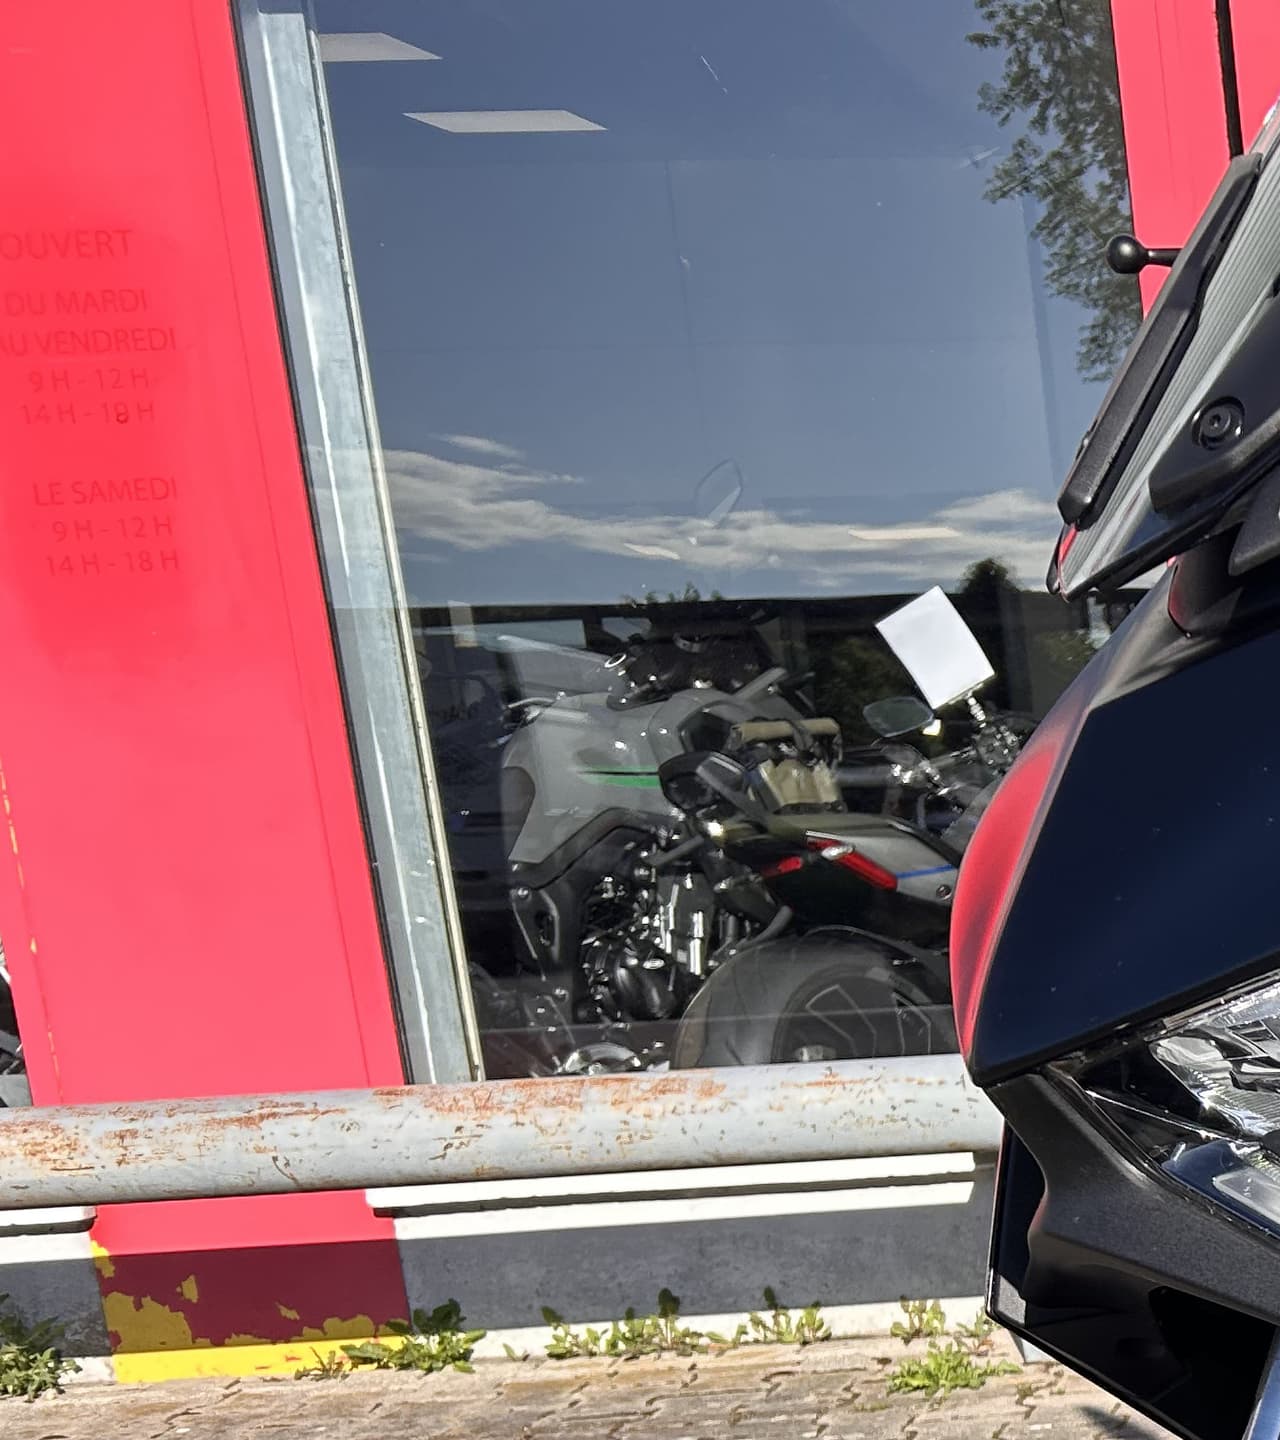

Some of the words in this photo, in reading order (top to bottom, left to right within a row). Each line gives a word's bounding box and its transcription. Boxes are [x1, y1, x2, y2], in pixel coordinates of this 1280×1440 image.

[0, 229, 133, 261] OUVERT
[4, 290, 47, 317] DU
[55, 288, 149, 314] MARDI
[33, 326, 177, 356] VENDREDI
[27, 370, 43, 393] 9
[51, 368, 72, 392] H
[95, 368, 125, 391] 12
[131, 367, 150, 389] H
[20, 403, 52, 425] 14
[57, 401, 77, 424] H
[101, 401, 129, 425] 18
[137, 400, 155, 423] H
[32, 482, 65, 506] LE
[71, 476, 178, 505] SAMEDI
[52, 520, 67, 543] 9
[74, 519, 94, 541] H
[117, 516, 147, 539] 12
[154, 514, 173, 537] H
[45, 555, 74, 577] 14
[81, 552, 101, 576] H
[124, 551, 154, 573] 18
[160, 549, 180, 572] H
